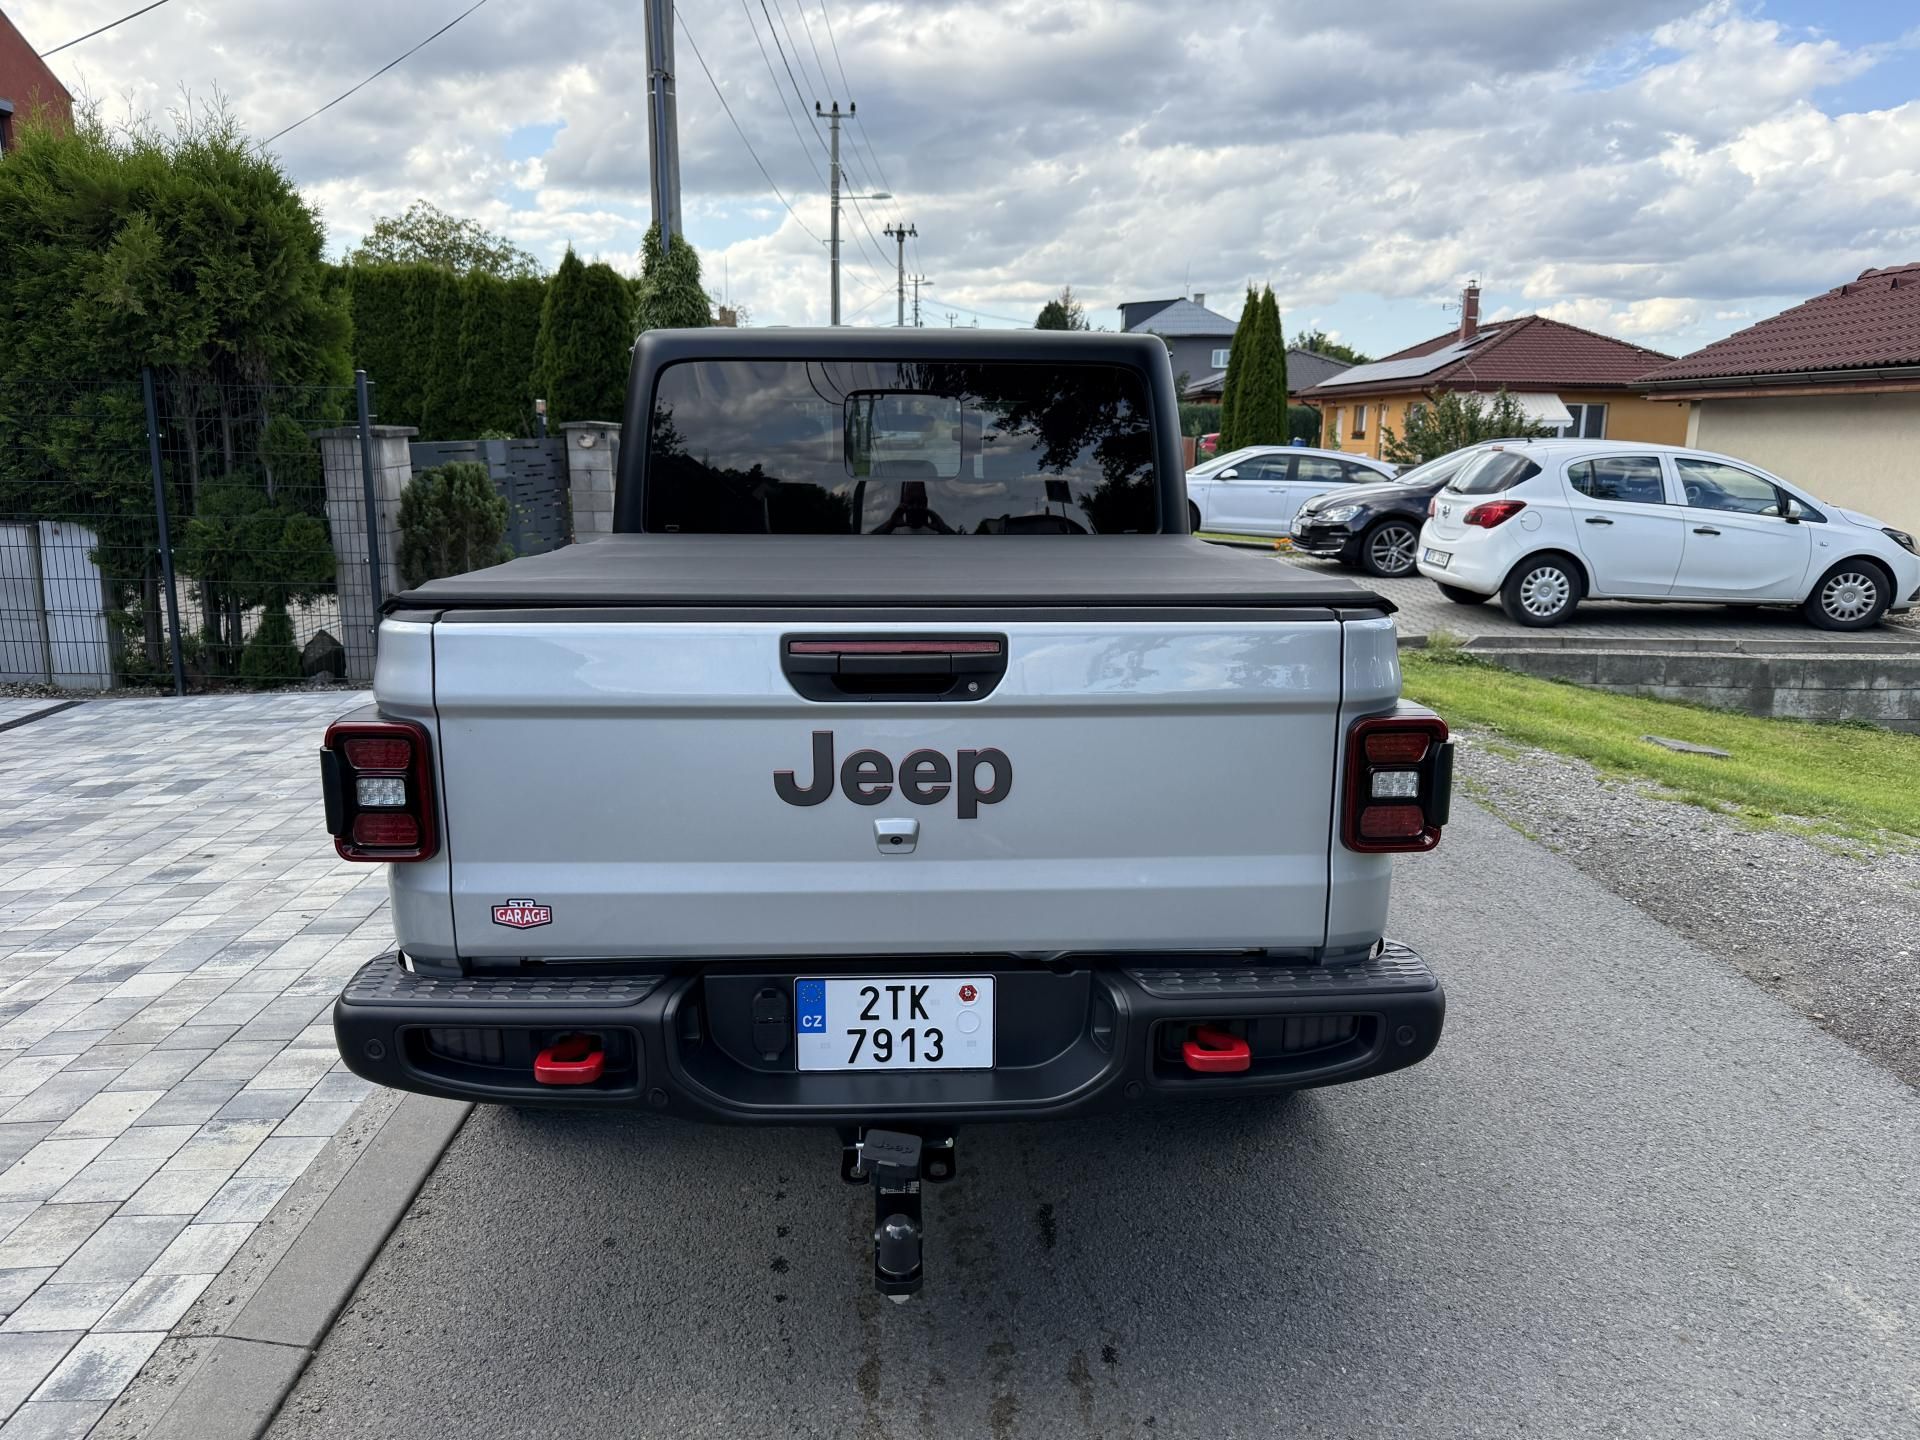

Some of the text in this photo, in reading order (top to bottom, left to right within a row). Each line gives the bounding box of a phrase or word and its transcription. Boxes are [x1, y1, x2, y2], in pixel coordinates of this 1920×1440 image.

[773, 730, 1013, 819] Jeep
[497, 909, 548, 924] GARAGE
[860, 985, 930, 1021] 2TK
[802, 1015, 823, 1028] CZ
[847, 1028, 944, 1064] 7913
